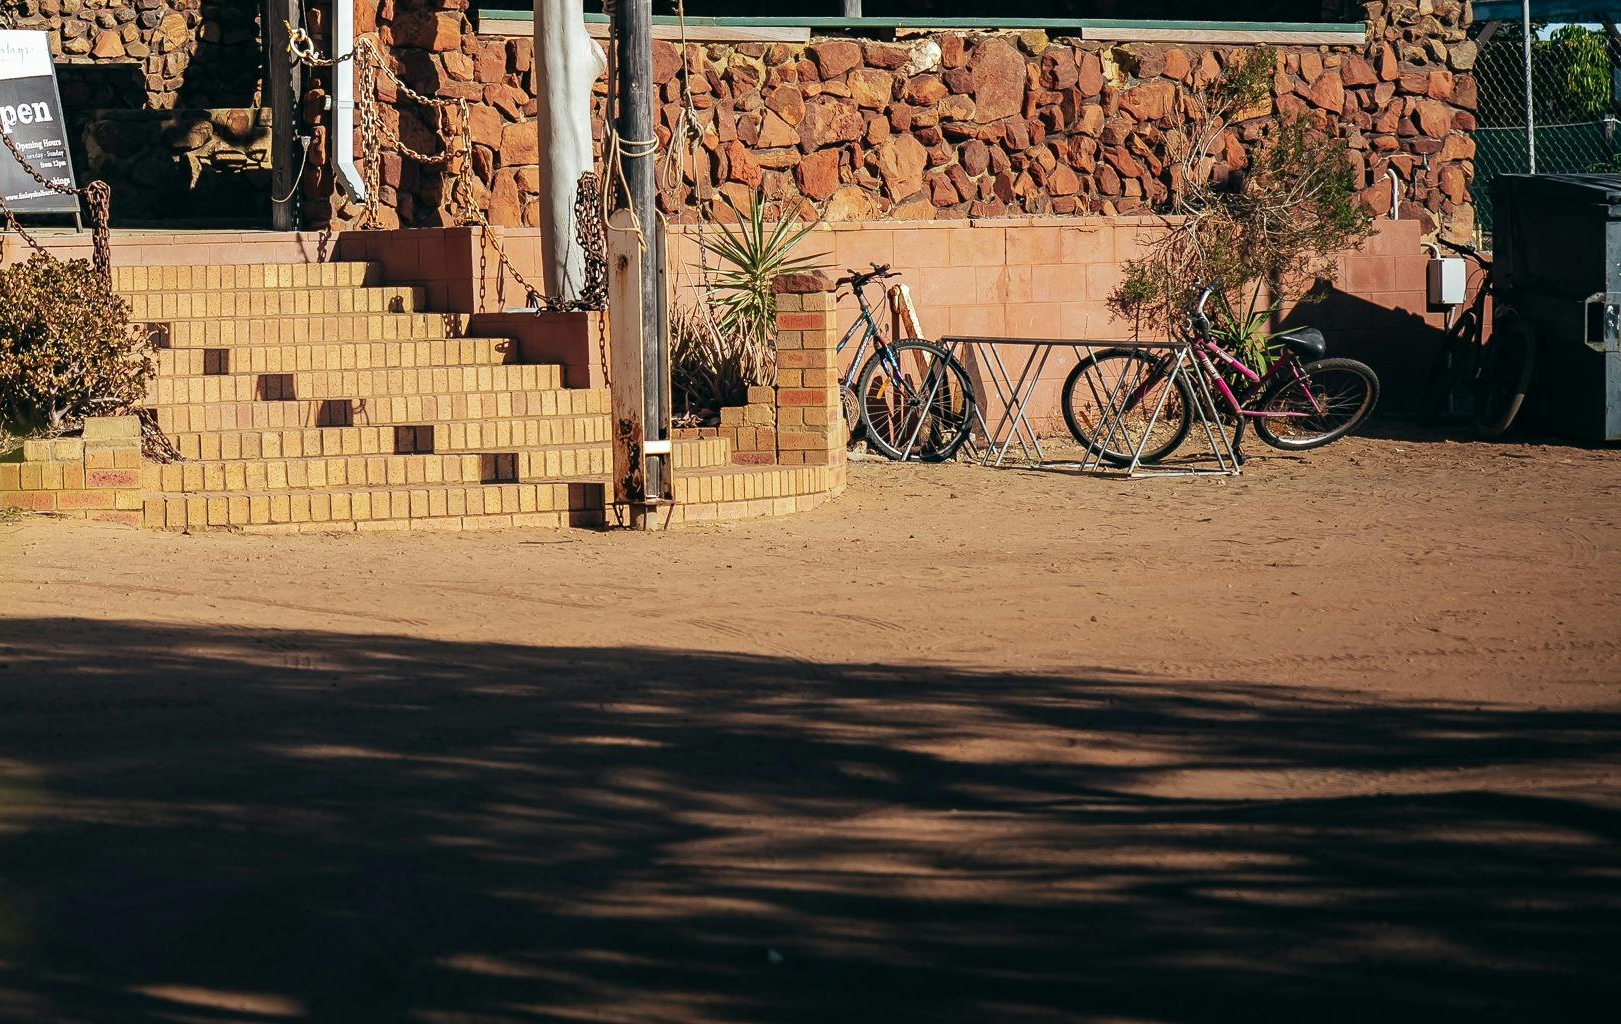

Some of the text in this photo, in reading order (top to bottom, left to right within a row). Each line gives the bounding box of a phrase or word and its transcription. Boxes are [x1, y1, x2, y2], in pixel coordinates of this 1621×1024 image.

[16, 139, 61, 151] Opening Hours
[47, 150, 63, 158] Sunday
